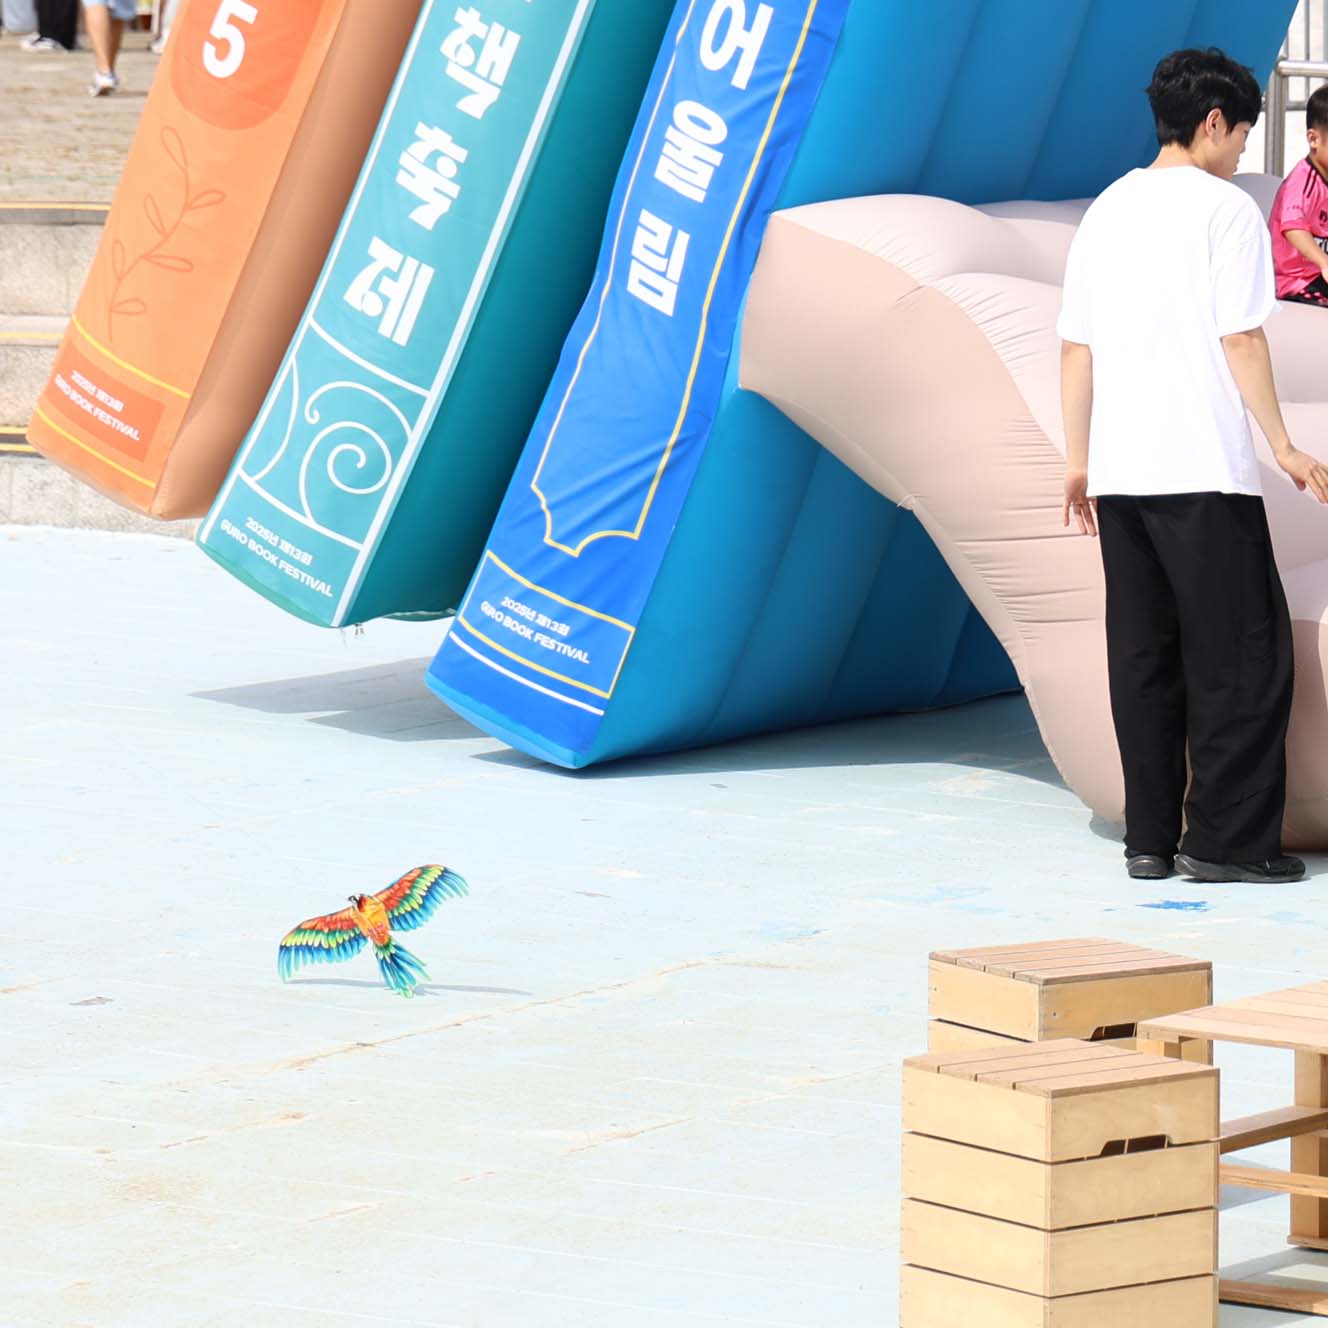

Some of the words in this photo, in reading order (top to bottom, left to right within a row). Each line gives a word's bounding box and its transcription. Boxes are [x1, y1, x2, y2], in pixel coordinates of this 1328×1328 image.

[93, 407, 140, 441] FESTIVAL
[220, 519, 248, 545] GURO
[247, 538, 280, 567] BOOK
[278, 559, 333, 598] FESTIVAL
[502, 615, 534, 640] BOOK
[533, 632, 590, 665] FESTIVAL
